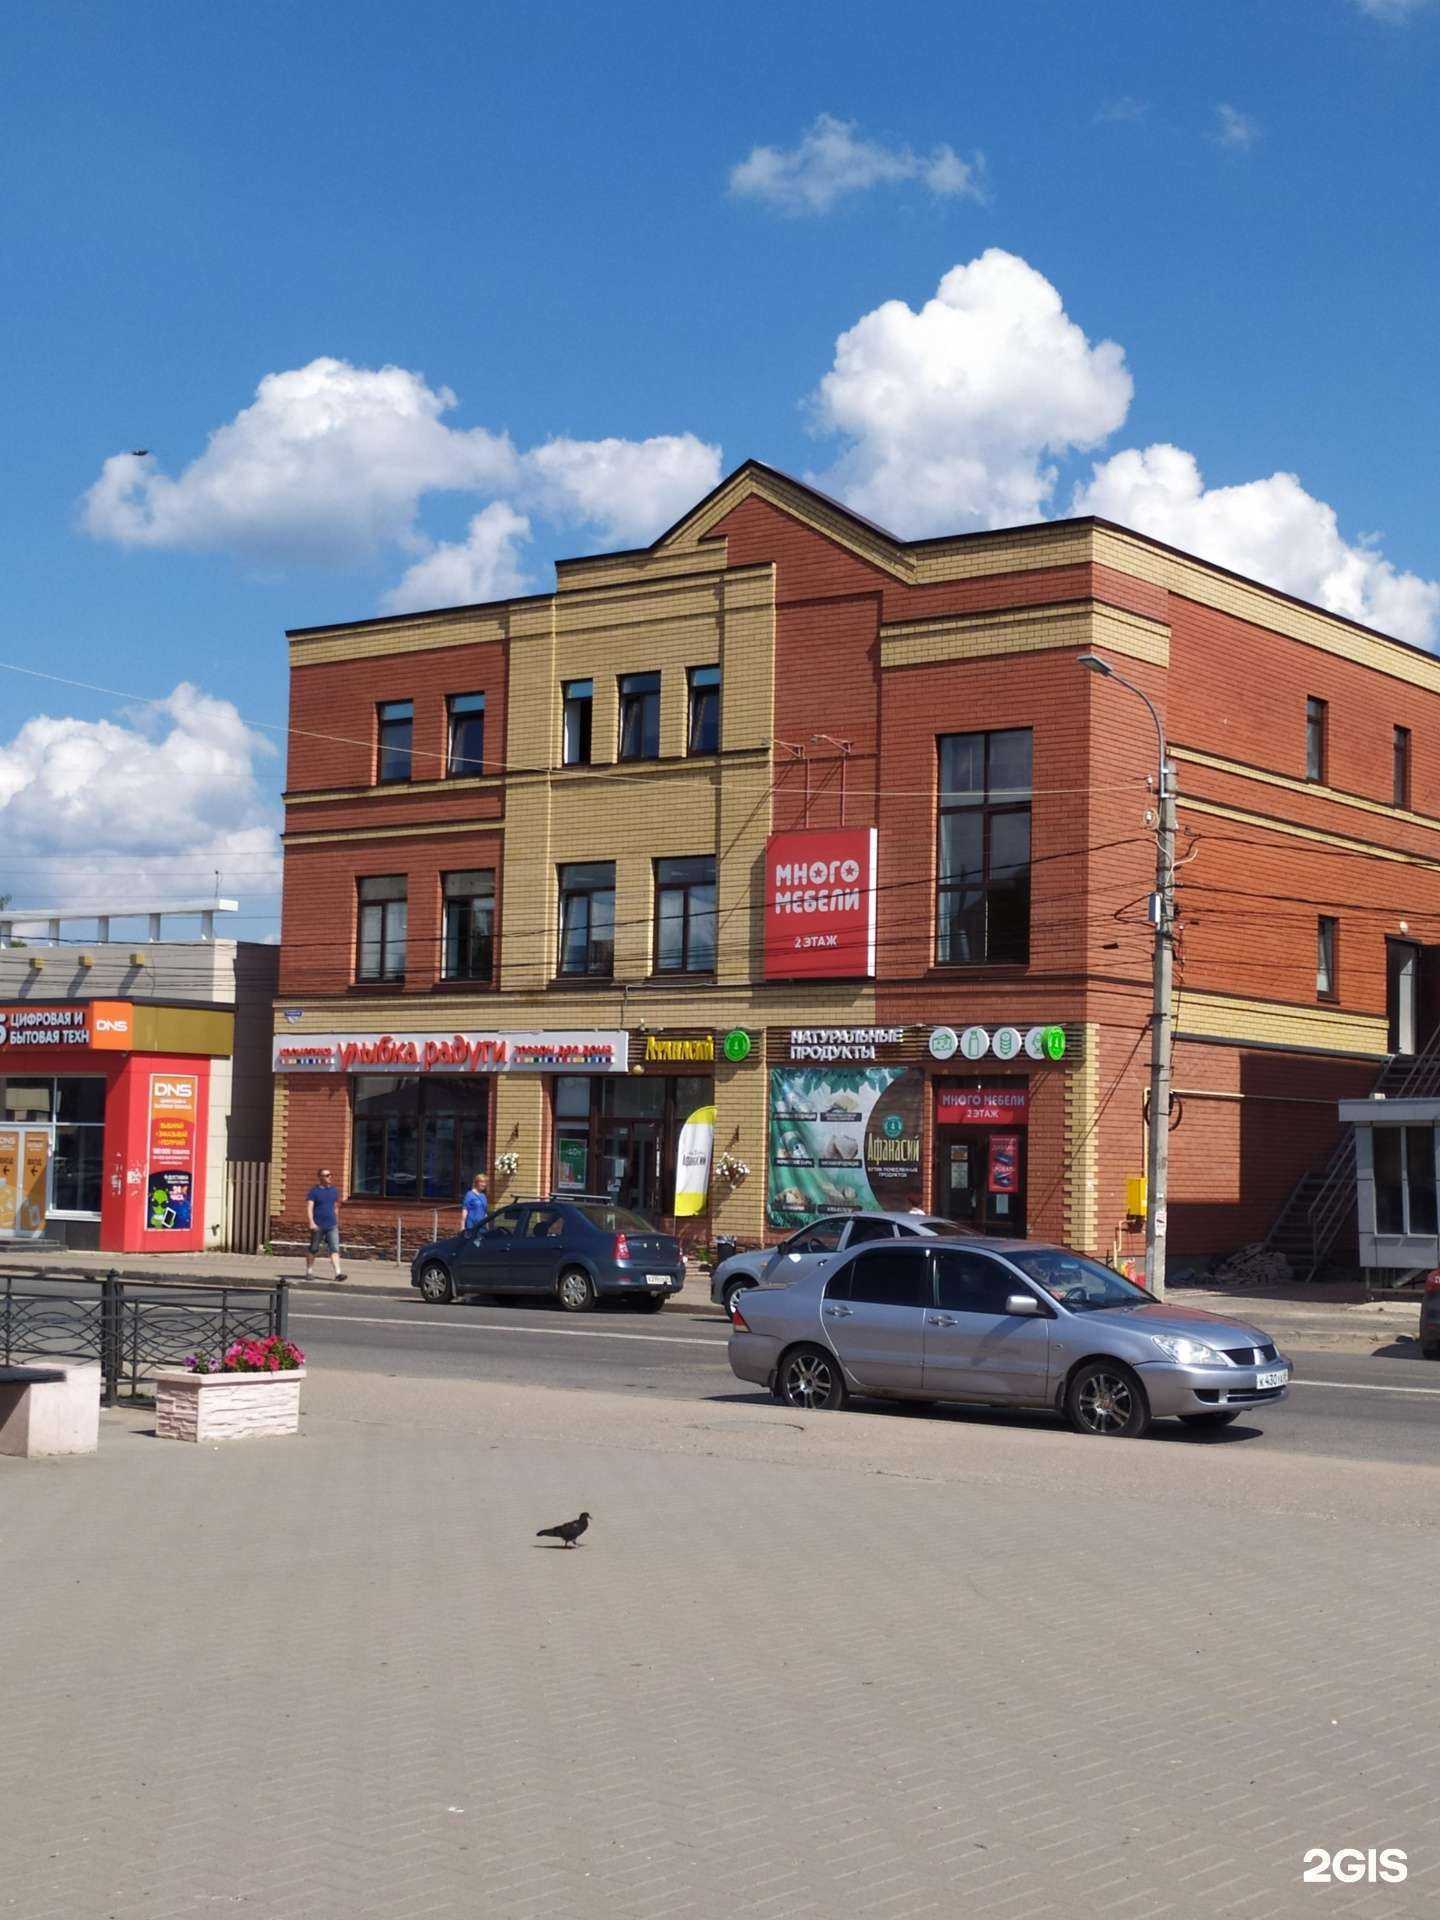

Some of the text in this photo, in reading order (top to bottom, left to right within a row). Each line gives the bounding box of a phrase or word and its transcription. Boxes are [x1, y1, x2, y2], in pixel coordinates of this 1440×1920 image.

[775, 860, 860, 886] МНОГО
[775, 888, 860, 914] МЕБЕЛИ
[794, 935, 838, 948] 2 ЭТАЖ
[10, 1012, 83, 1028] ЦИФРОВАЯ И
[96, 1019, 128, 1032] DNS
[9, 1030, 60, 1044] БЫТОВАЯ
[790, 1029, 903, 1044] НАТУРАЛЬНЫЕ
[790, 1045, 875, 1061] ПРОДУКТЫ
[154, 1083, 193, 1097] DNS
[942, 1095, 1025, 1106] МНОГО МЕБЕЛИ
[972, 1109, 999, 1118] ЭТАЖ
[867, 1133, 920, 1165] Афанасий
